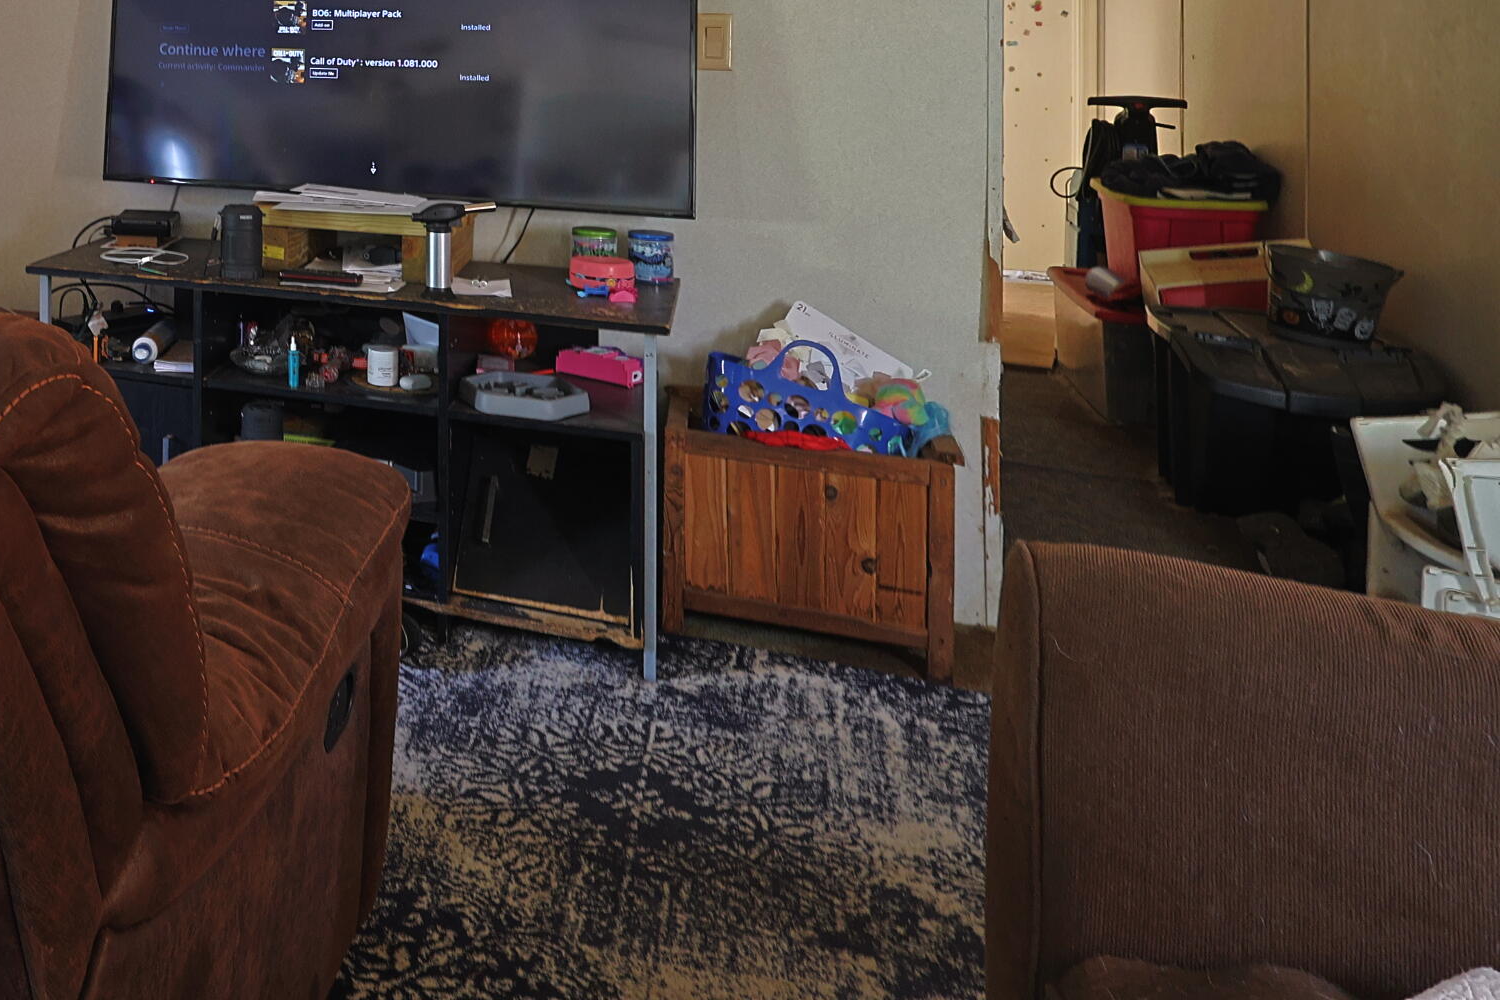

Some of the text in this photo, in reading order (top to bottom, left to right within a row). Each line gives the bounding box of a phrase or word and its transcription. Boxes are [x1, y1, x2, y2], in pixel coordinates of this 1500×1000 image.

[312, 9, 402, 19] BO6: Multiplayer Pack
[159, 42, 266, 58] Continue where
[310, 57, 325, 65] Call
[326, 57, 335, 65] of
[365, 58, 396, 67] version
[397, 59, 438, 68] 1.081.000
